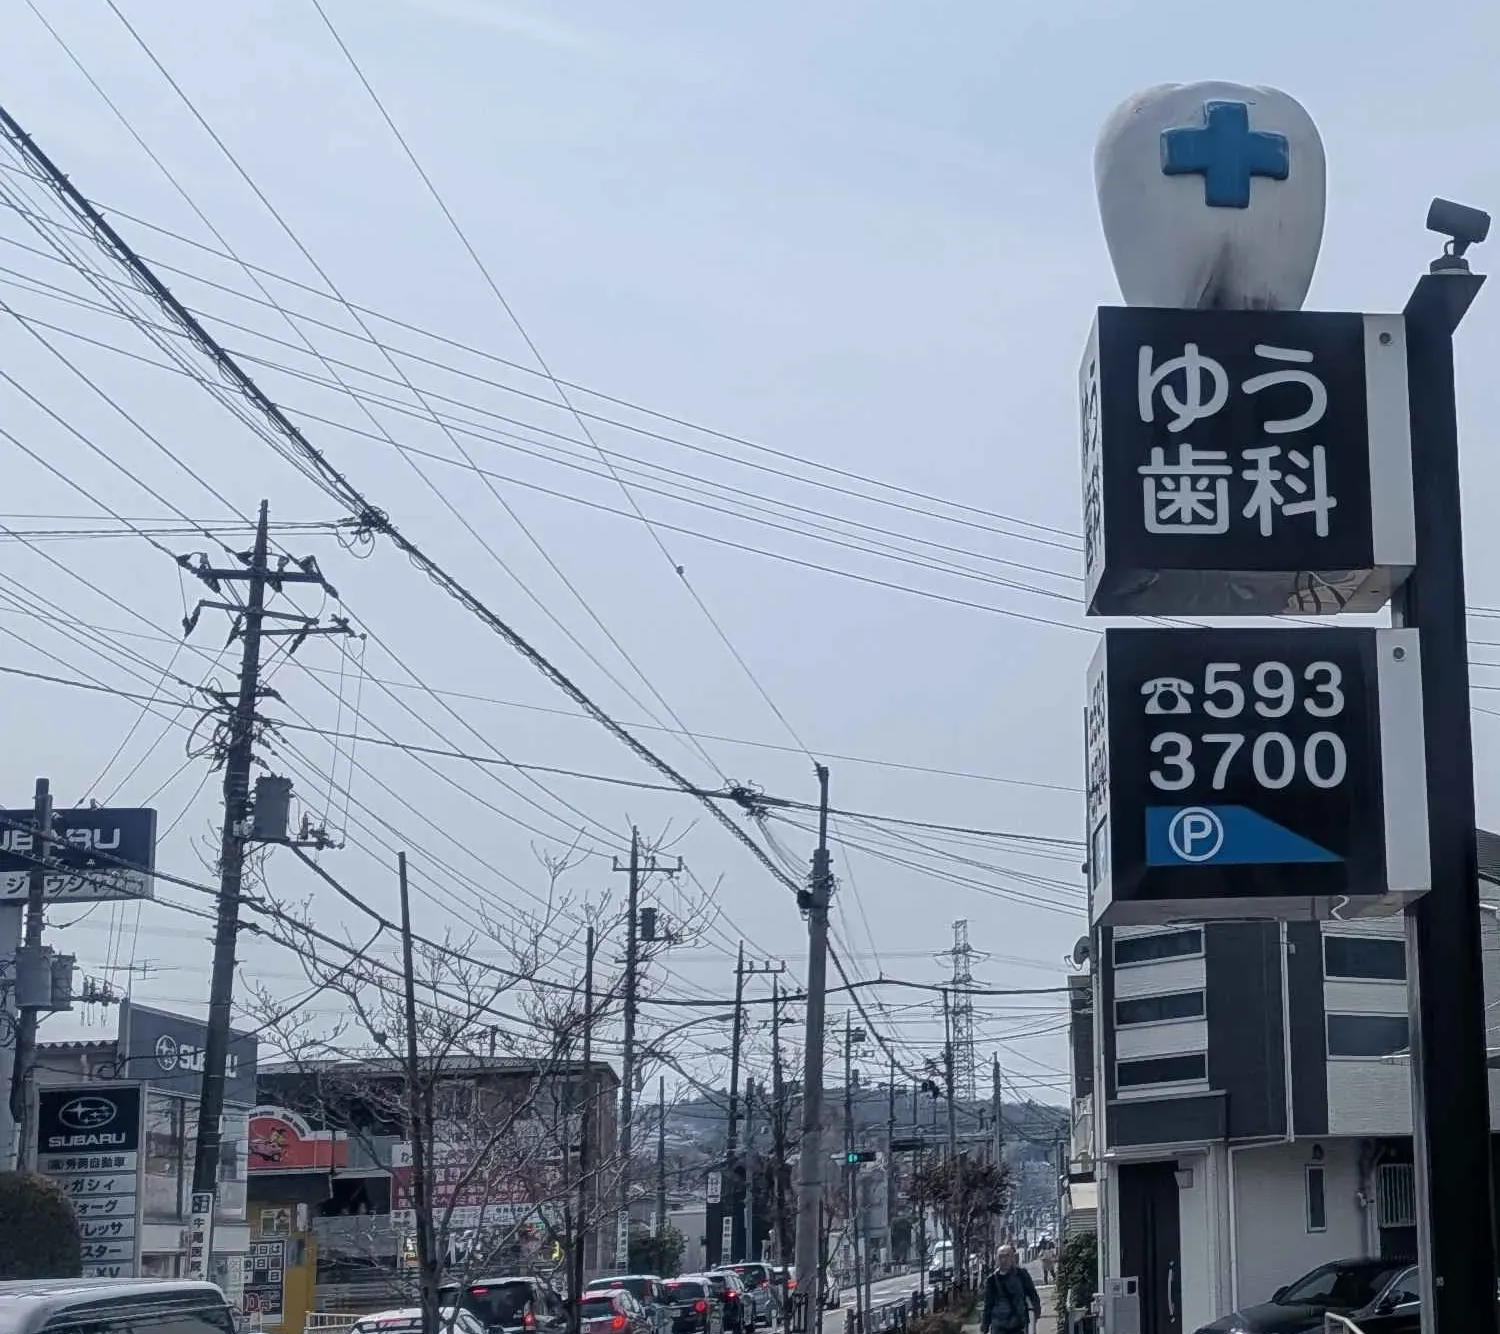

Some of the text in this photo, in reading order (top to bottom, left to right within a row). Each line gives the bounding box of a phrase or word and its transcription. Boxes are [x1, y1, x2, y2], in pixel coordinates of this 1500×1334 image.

[1138, 343, 1327, 433] ゆう
[1137, 443, 1338, 537] 歯科
[1202, 661, 1345, 718] 593
[1149, 731, 1347, 791] 3700
[48, 1132, 126, 1147] SUBARU
[64, 1178, 115, 1193] ガシィ
[72, 1199, 119, 1214] ォーグ
